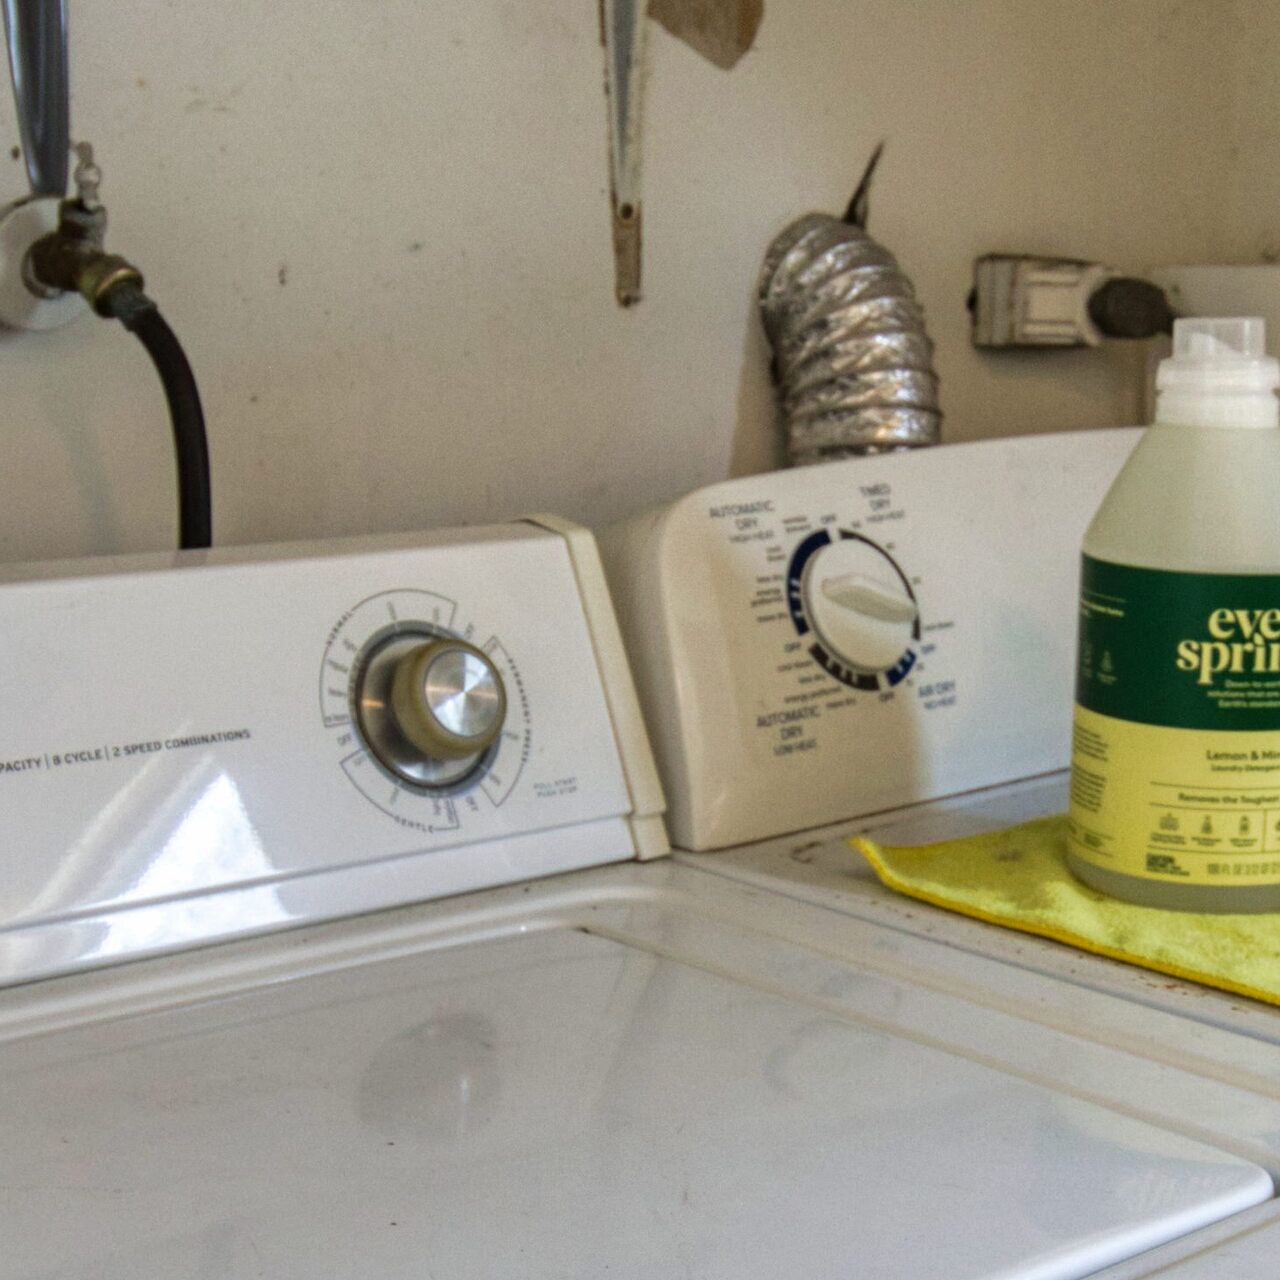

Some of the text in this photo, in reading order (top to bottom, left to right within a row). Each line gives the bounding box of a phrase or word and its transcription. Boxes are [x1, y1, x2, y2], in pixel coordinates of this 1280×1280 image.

[64, 750, 102, 764] CYCLE
[112, 746, 121, 757] 2
[124, 741, 162, 756] SPEED
[164, 728, 251, 750] COMBINATIONS
[1206, 750, 1248, 760] Lemon
[1251, 750, 1259, 760] &
